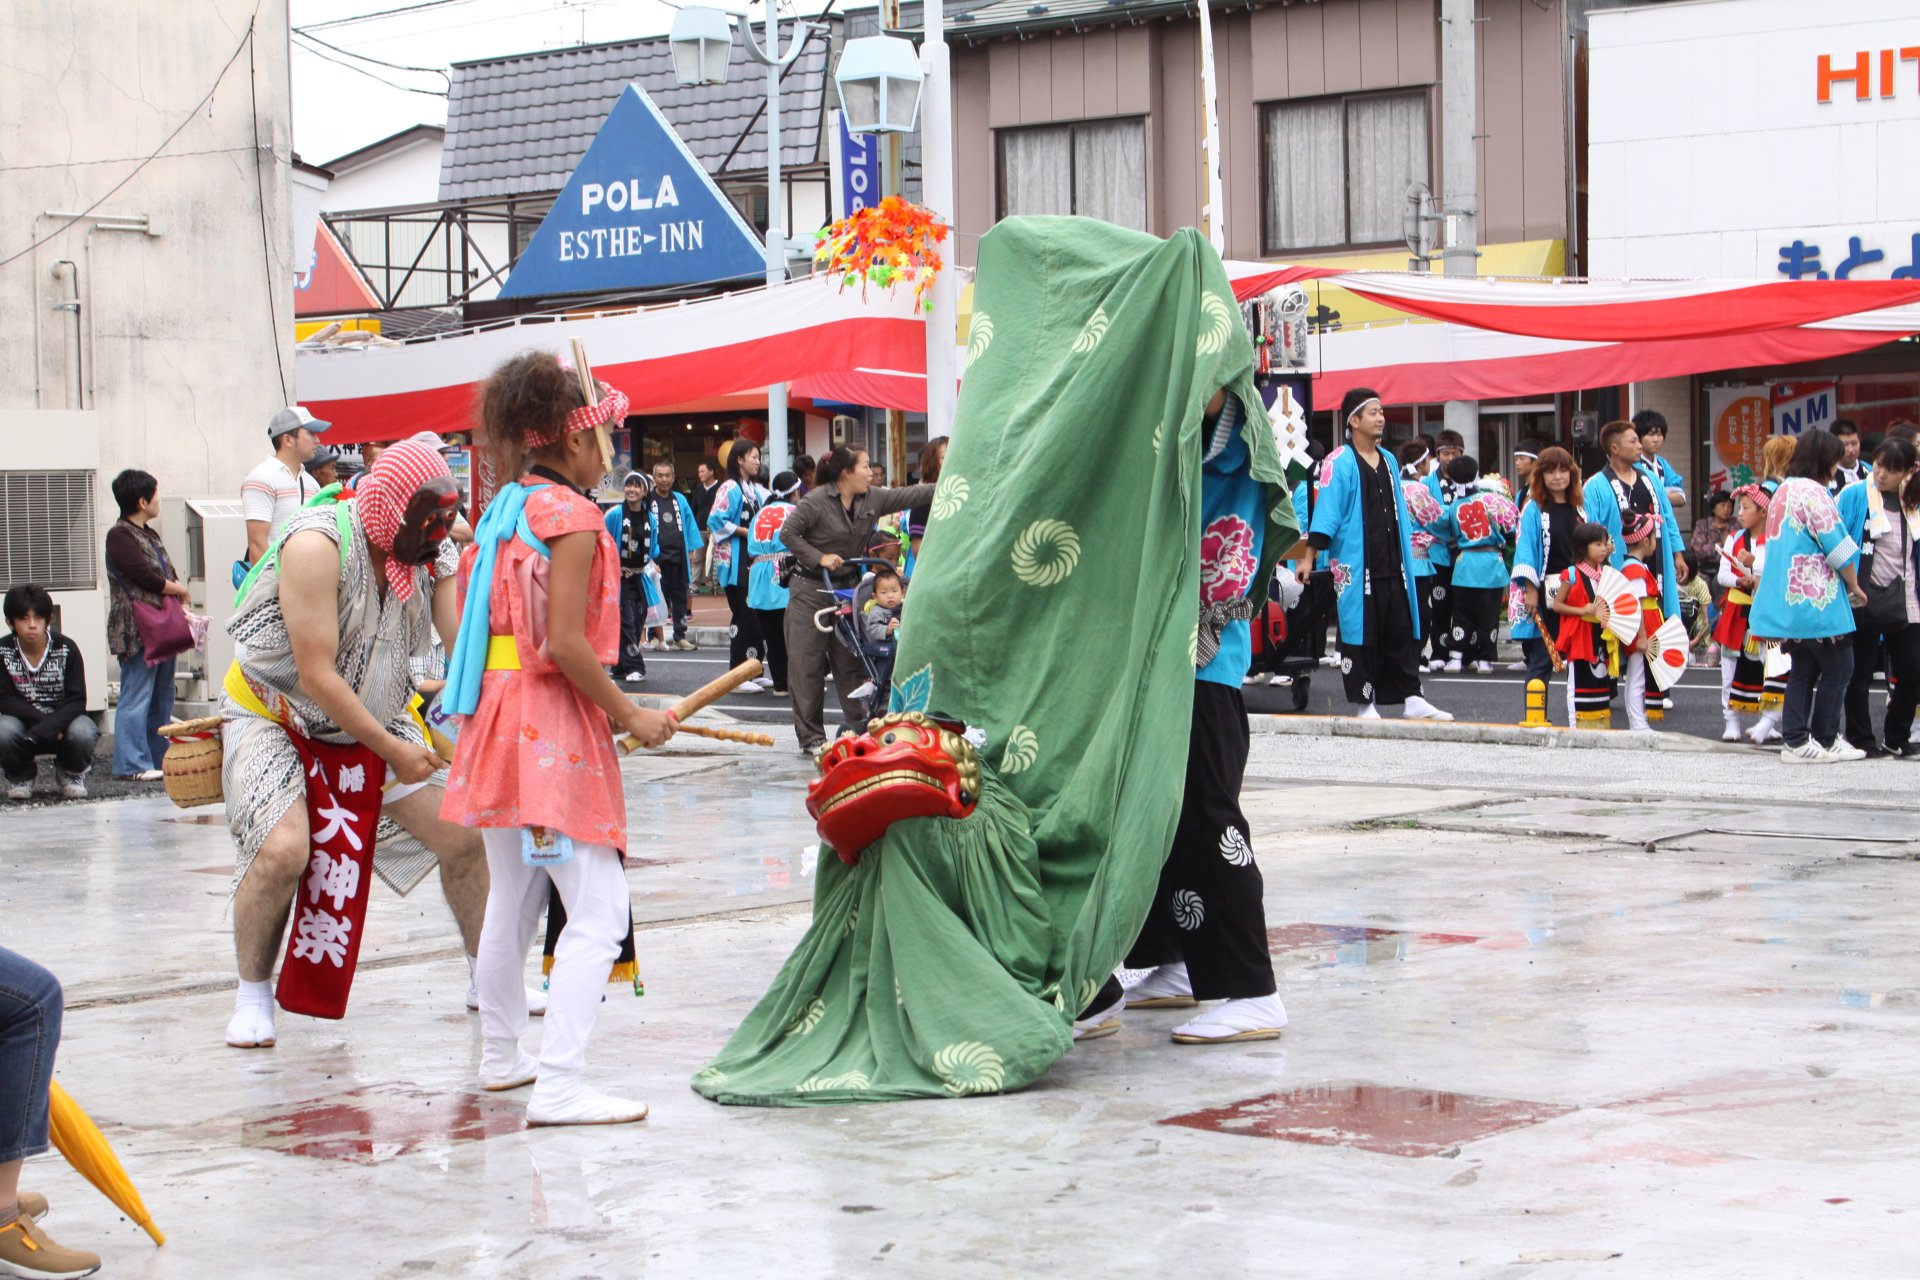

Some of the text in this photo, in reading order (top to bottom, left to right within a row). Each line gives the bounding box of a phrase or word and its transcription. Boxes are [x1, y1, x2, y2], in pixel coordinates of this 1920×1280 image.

[582, 174, 680, 216] POLA
[848, 132, 869, 214] POLA
[292, 792, 363, 969] 大神楽
